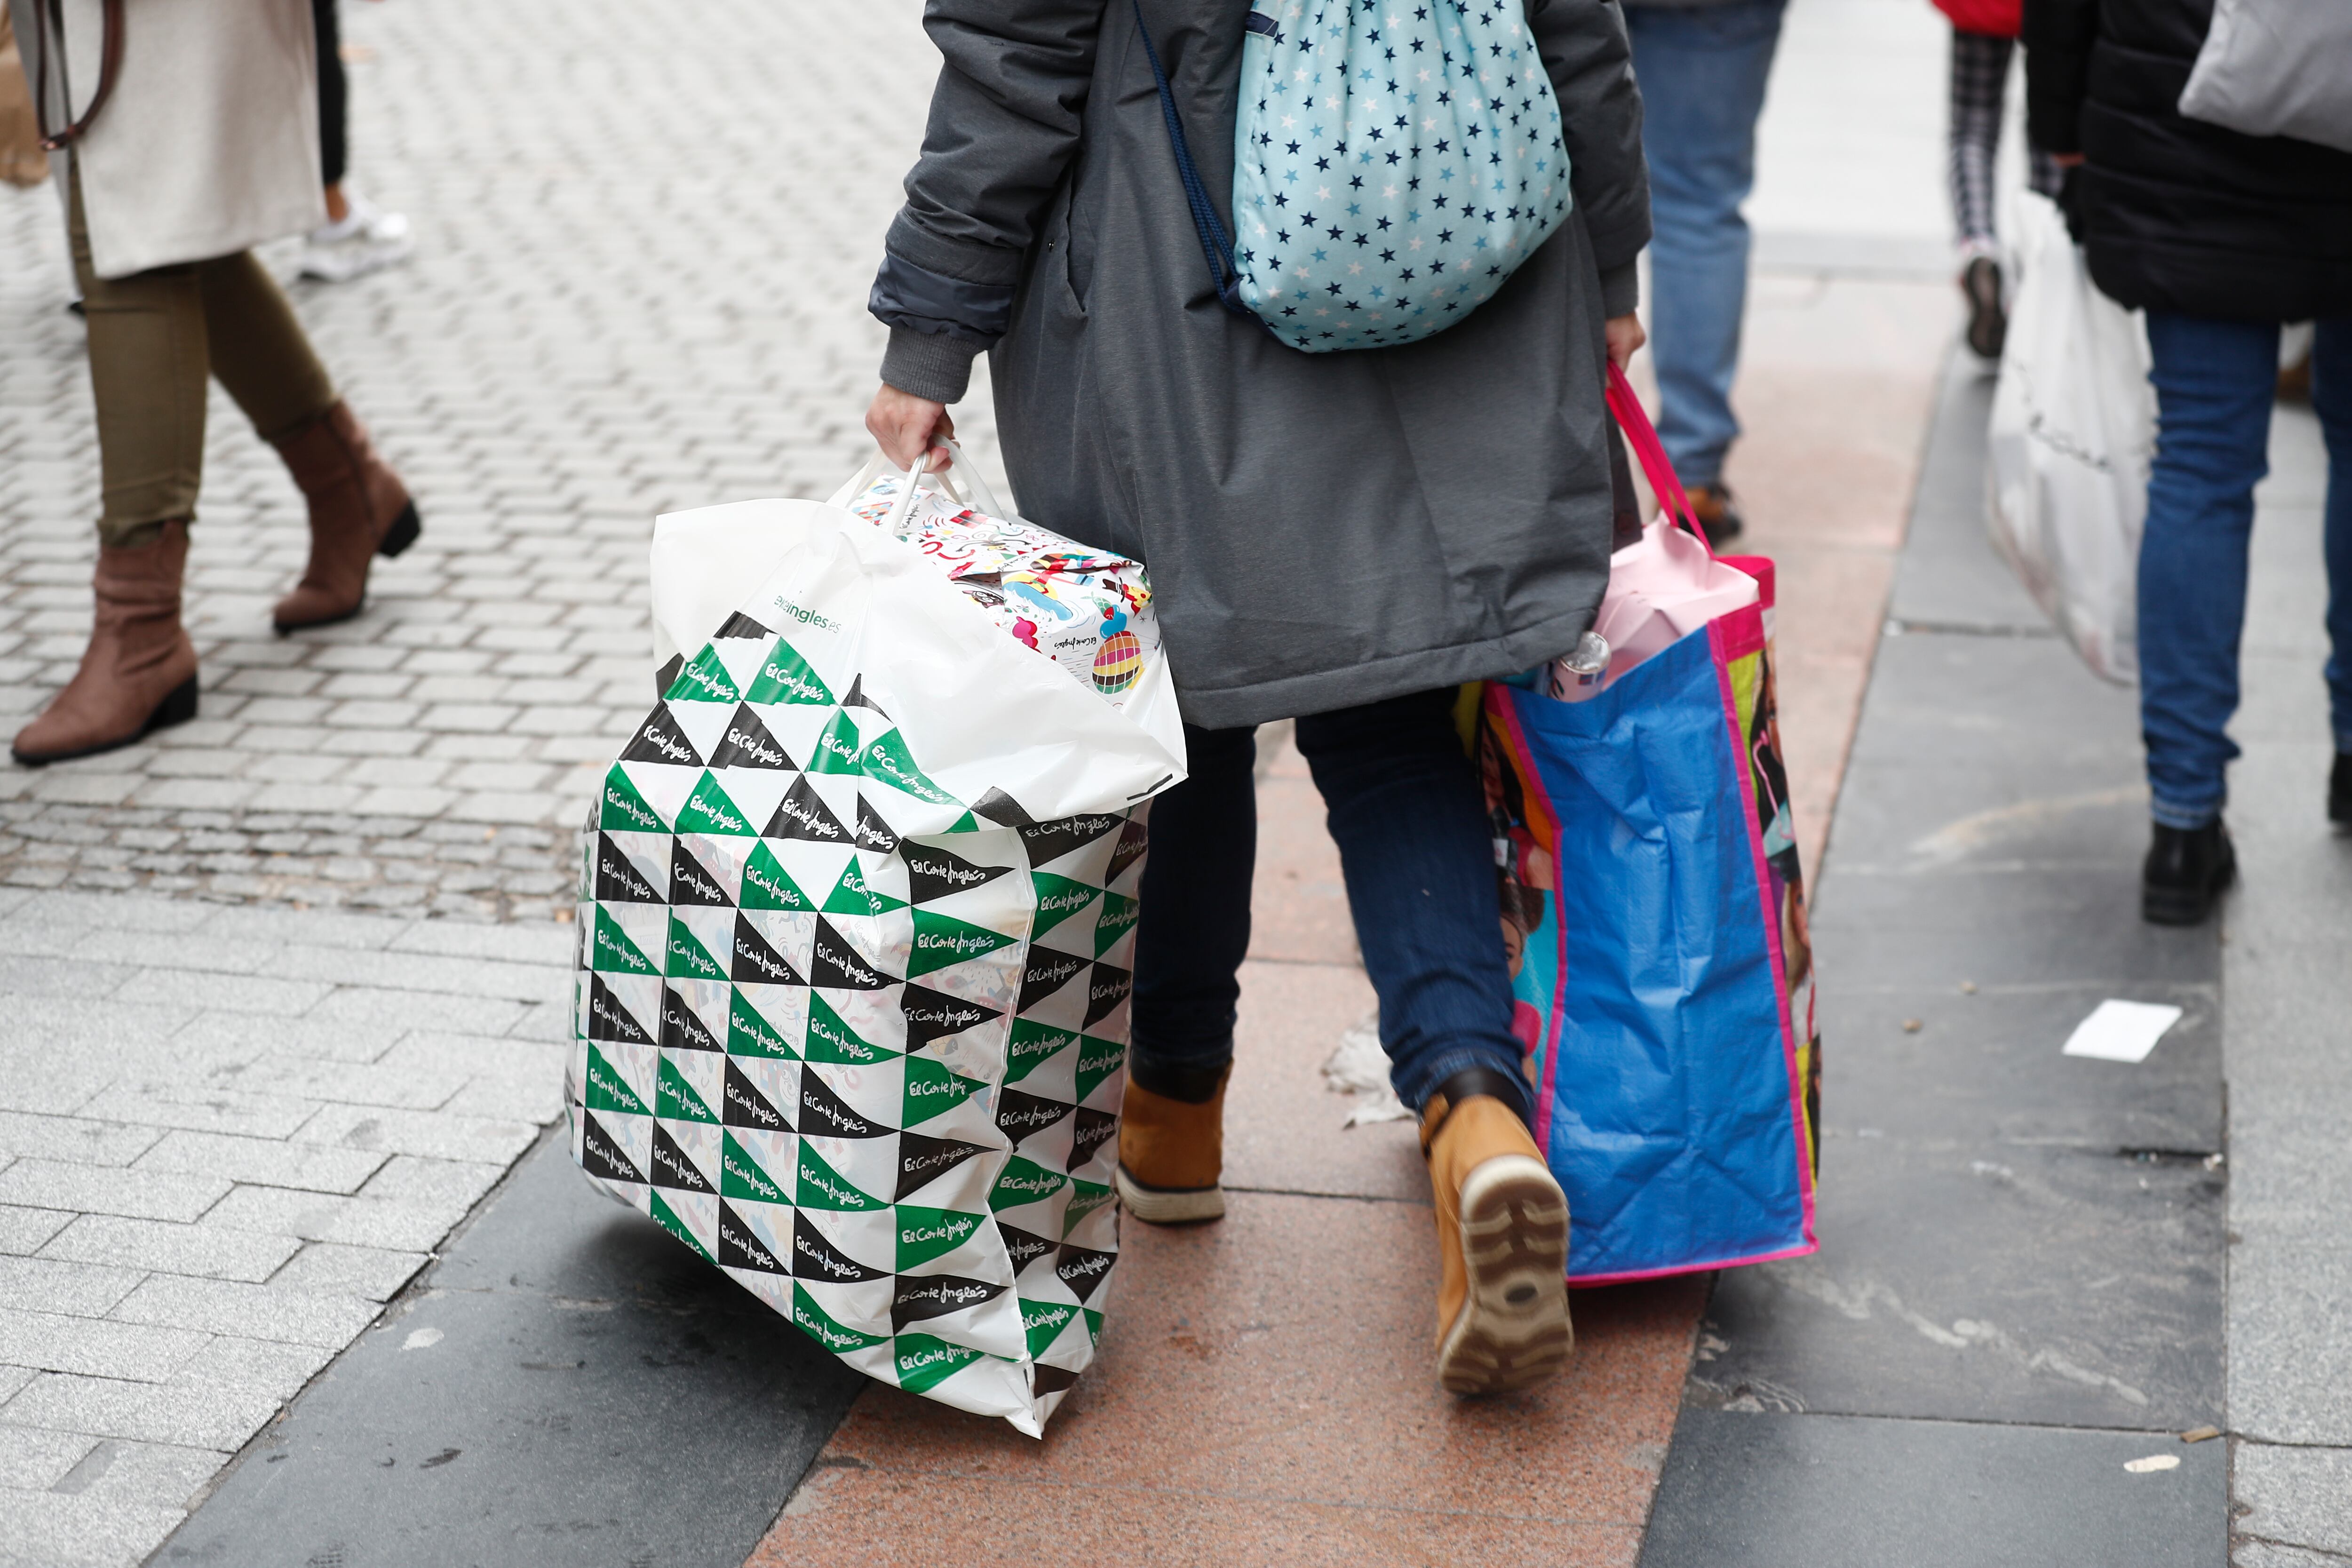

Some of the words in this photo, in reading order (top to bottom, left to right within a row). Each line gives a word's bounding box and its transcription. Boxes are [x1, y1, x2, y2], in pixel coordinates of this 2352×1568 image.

[765, 663, 779, 678] El
[792, 675, 823, 700] Inglés
[661, 735, 691, 762] Inglés
[728, 728, 741, 744] El
[751, 739, 783, 766] Inglés
[821, 732, 835, 748] El
[832, 740, 852, 758] Corte
[872, 745, 886, 761] El
[881, 757, 908, 779] Corte
[902, 777, 944, 802] Inglés
[607, 788, 615, 802] El
[615, 792, 632, 814] Corte
[632, 800, 657, 828] Inglés
[710, 805, 742, 832] Inglés
[782, 799, 793, 813] El
[791, 803, 810, 823] Corte
[805, 811, 839, 838] Inglés
[1072, 816, 1110, 836] Inglés
[602, 859, 610, 874] El
[609, 865, 626, 883] Corte
[626, 871, 651, 899] Inglés
[696, 873, 721, 902] Inglés
[747, 865, 754, 881] El
[754, 870, 771, 892] Corte
[771, 877, 800, 907] Inglés
[842, 873, 855, 888] El
[911, 860, 924, 874] El
[924, 861, 947, 879] Corte
[947, 860, 985, 885] Inglés
[1041, 897, 1050, 911] El
[1049, 895, 1066, 909] Corte
[1065, 889, 1089, 911] Inglés
[598, 930, 606, 945] El
[605, 936, 621, 955] Corte
[621, 942, 646, 970] Inglés
[736, 938, 744, 954] El
[743, 944, 761, 964] Corte
[761, 950, 790, 980] Inglés
[918, 933, 930, 948] El
[930, 934, 955, 948] Corte
[956, 931, 995, 954] Inglés
[691, 947, 716, 976] Inglés
[817, 942, 826, 958] El
[826, 948, 845, 969] Corte
[845, 955, 878, 986] Inglés
[1027, 969, 1036, 982] El
[1036, 968, 1053, 981] Corte
[1053, 960, 1077, 982] Inglés
[593, 998, 601, 1014] El
[601, 1005, 617, 1025] Corte
[617, 1011, 641, 1040] Inglés
[684, 1018, 710, 1046] Inglés
[732, 1012, 740, 1028] El
[739, 1018, 757, 1039] Corte
[757, 1025, 785, 1055] Inglés
[904, 1008, 915, 1021] El
[915, 1008, 944, 1022] Corte
[944, 1005, 981, 1027] Inglés
[811, 1018, 820, 1033] El
[819, 1024, 839, 1046] Corte
[839, 1031, 874, 1060] Inglés
[1012, 1042, 1020, 1057] El
[1020, 1041, 1039, 1054] Corte
[1038, 1034, 1066, 1055] Inglés
[590, 1068, 598, 1084] El
[597, 1074, 614, 1094] Corte
[614, 1081, 638, 1110] Inglés
[658, 1077, 665, 1092] El
[665, 1082, 682, 1103] Corte
[682, 1089, 707, 1119] Inglés
[727, 1083, 735, 1099] El
[734, 1089, 752, 1110] Corte
[752, 1097, 779, 1126] Inglés
[909, 1081, 922, 1096] El
[804, 1091, 813, 1106] El
[812, 1097, 832, 1119] Corte
[832, 1104, 867, 1133] Inglés
[1001, 1113, 1010, 1126] El
[1010, 1111, 1030, 1125] Corte
[1030, 1106, 1061, 1126] Inglés
[587, 1136, 594, 1151] El
[593, 1141, 610, 1162] Corte
[610, 1148, 633, 1178] Inglés
[654, 1145, 662, 1160] El
[661, 1151, 678, 1172] Corte
[678, 1158, 703, 1188] Inglés
[904, 1158, 915, 1172] El
[916, 1154, 938, 1169] Corte
[938, 1147, 974, 1165] Inglés
[724, 1155, 732, 1171] El
[732, 1161, 750, 1184] Corte
[750, 1169, 778, 1200] Inglés
[801, 1164, 810, 1180] El
[809, 1170, 828, 1193] Corte
[829, 1178, 865, 1208] Inglés
[1000, 1176, 1011, 1188] El
[1011, 1178, 1035, 1190] Corte
[1034, 1173, 1061, 1194] Inglés
[722, 1224, 730, 1241] El
[729, 1230, 747, 1252] Corte
[747, 1238, 774, 1269] Inglés
[902, 1229, 915, 1244] El
[916, 1226, 946, 1242] Corte
[944, 1217, 973, 1242] Inglés
[796, 1235, 805, 1252] El
[805, 1243, 823, 1265] Corte
[824, 1250, 861, 1278] Inglés
[1058, 1267, 1070, 1280] El
[1067, 1264, 1084, 1278] Corte
[1081, 1255, 1109, 1276] Inglés
[940, 1281, 988, 1304] Inglés
[796, 1307, 804, 1323] El
[803, 1315, 823, 1337] Corte
[822, 1322, 863, 1348] Inglés
[899, 1355, 914, 1370] El
[914, 1350, 946, 1368] Corte
